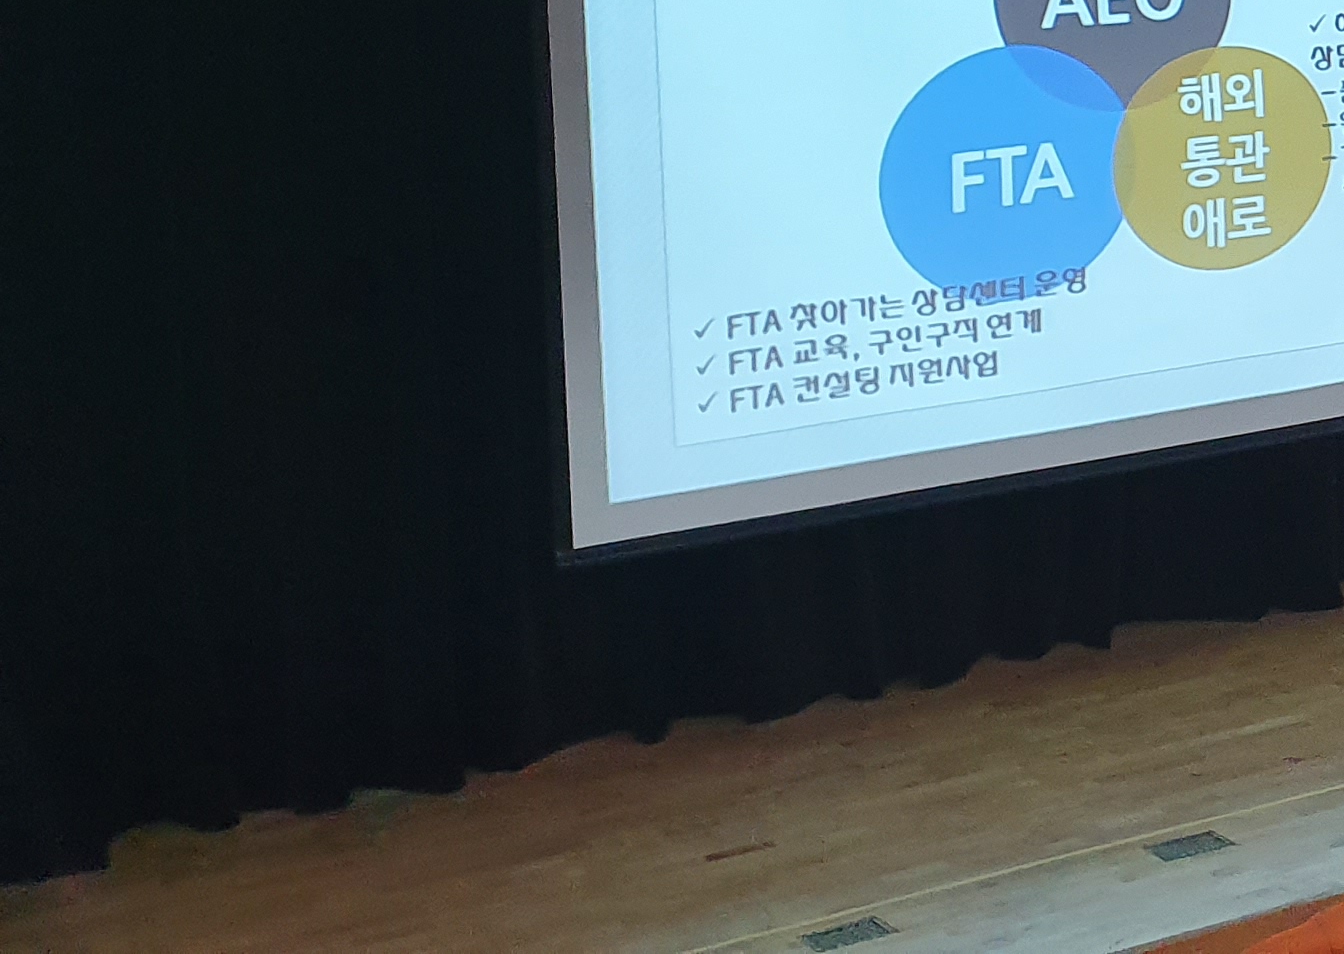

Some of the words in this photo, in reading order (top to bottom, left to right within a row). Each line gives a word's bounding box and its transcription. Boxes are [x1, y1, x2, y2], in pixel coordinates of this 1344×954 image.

[1177, 69, 1265, 123] 해외
[951, 142, 1074, 213] FTA
[1181, 134, 1269, 188] 통관
[1182, 196, 1272, 248] 애로
[726, 310, 782, 340] FTA
[790, 294, 906, 331] 찾아가는
[911, 276, 1026, 316] 상담센터
[1034, 266, 1088, 297] 운영
[728, 346, 784, 375] FTA
[869, 315, 979, 356] 구인구직
[986, 308, 1043, 339] 연계
[730, 383, 785, 413] FTA
[793, 366, 880, 404] 컨설팅
[889, 350, 999, 389] 지원사업
